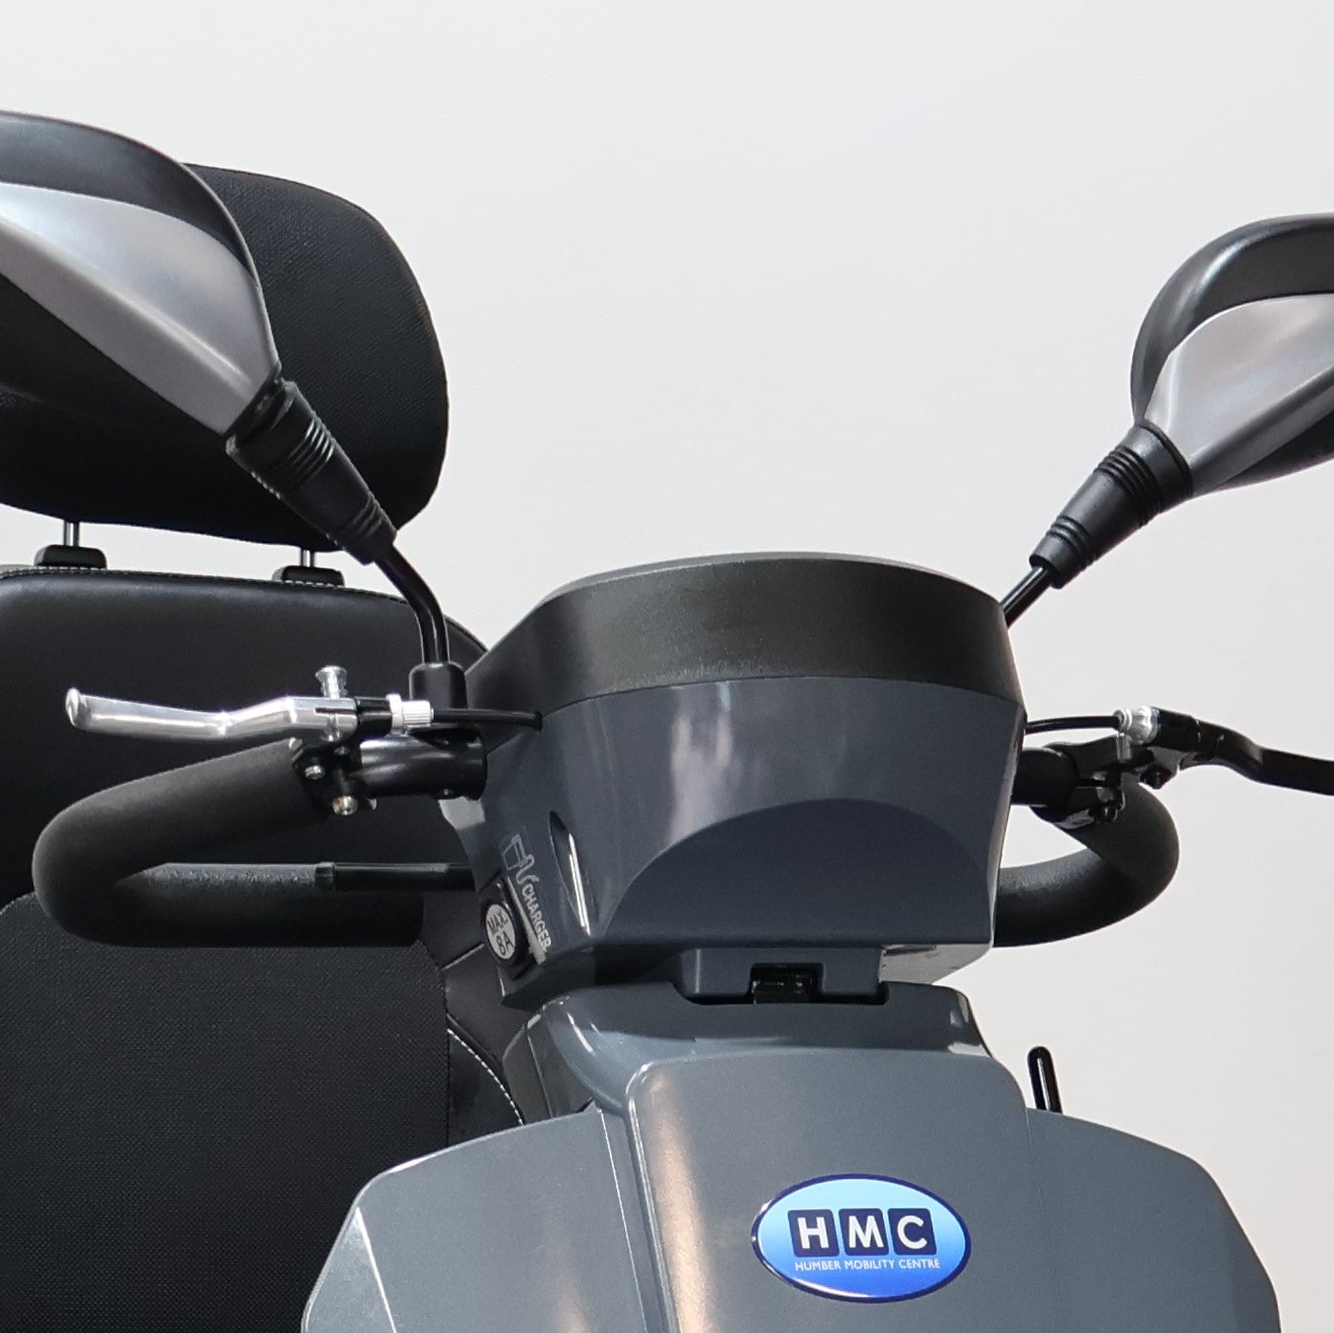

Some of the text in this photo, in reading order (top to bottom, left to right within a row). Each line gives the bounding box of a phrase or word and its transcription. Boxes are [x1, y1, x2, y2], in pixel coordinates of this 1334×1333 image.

[522, 883, 552, 953] CHARGER
[496, 930, 514, 956] 8A
[797, 1215, 928, 1250] HMC
[794, 1258, 941, 1272] HUMBER MOBILITY CENTRE
